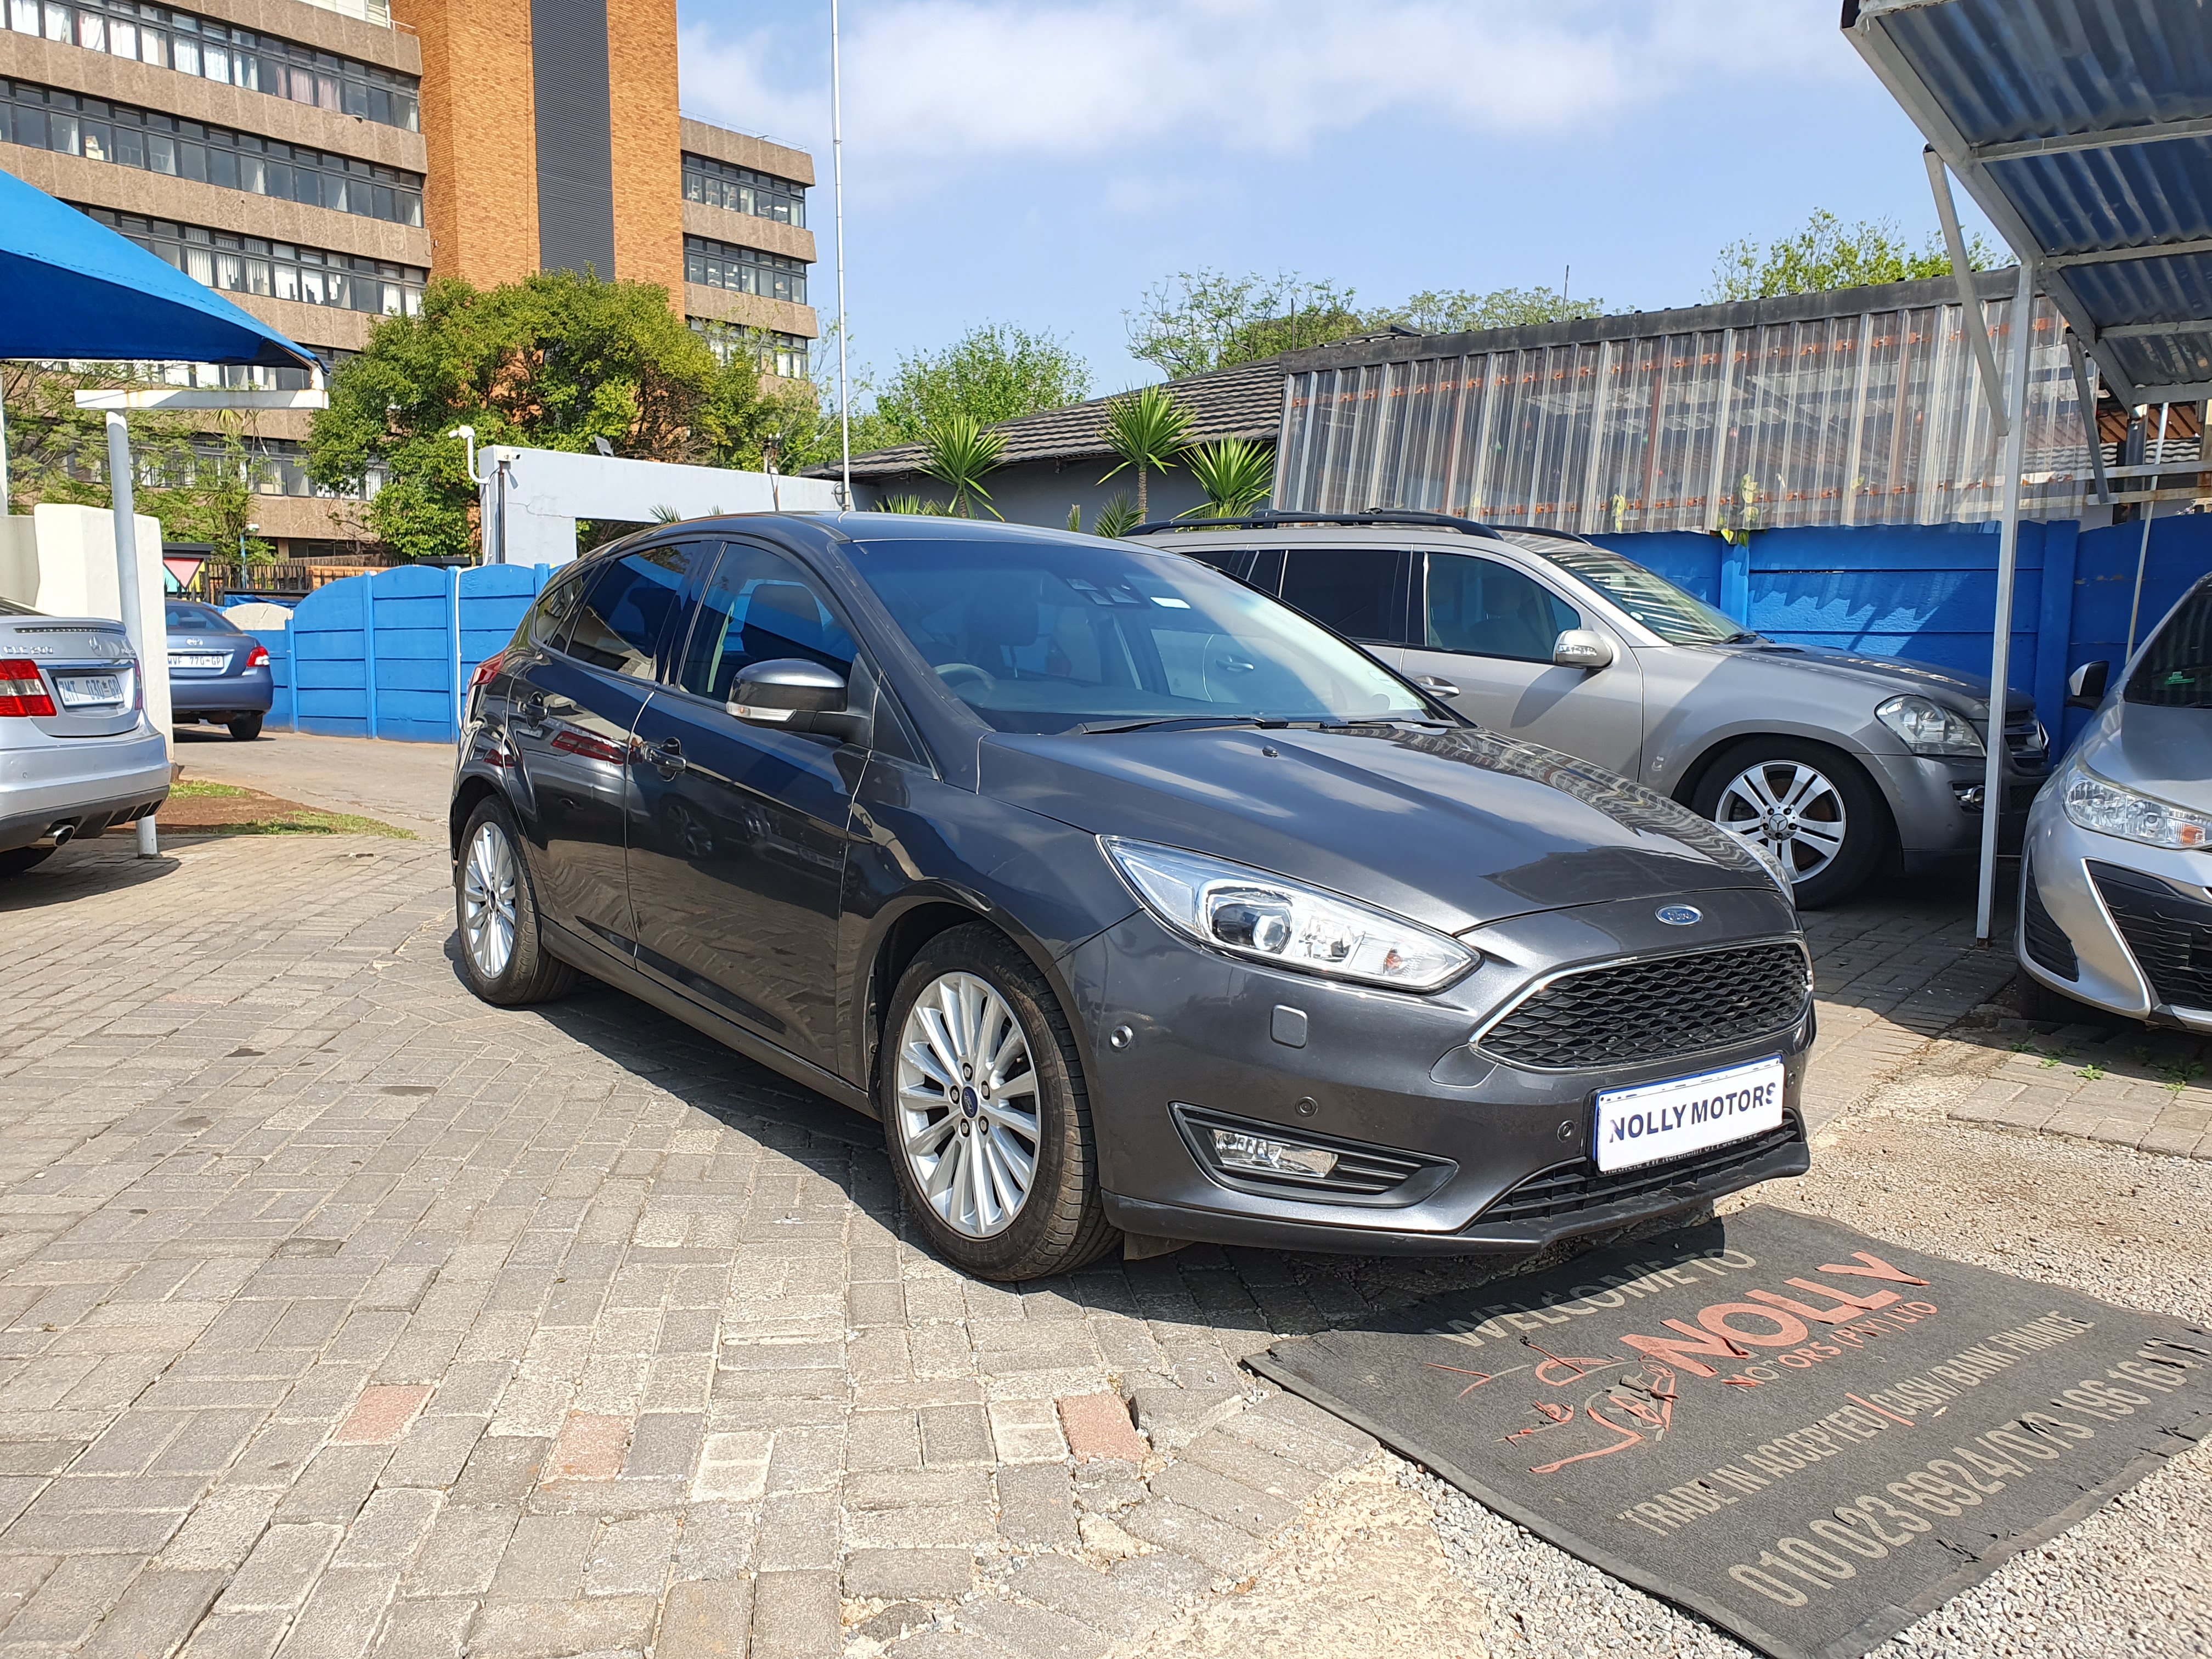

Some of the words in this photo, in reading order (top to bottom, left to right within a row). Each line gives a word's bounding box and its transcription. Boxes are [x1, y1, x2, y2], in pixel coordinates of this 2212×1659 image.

[59, 681, 80, 702] ZMT
[211, 656, 221, 665] GP
[1666, 909, 1694, 921] Ford
[1609, 1104, 1688, 1143] NOLLY
[1691, 1082, 1776, 1125] MOTORS
[1425, 1260, 1701, 1347] WELCOME
[1673, 1249, 1756, 1276] TO
[1620, 1250, 1931, 1378] NOLLY
[1720, 1341, 1842, 1392] MOTORS
[1883, 1301, 1938, 1324] LTD
[1615, 1477, 1740, 1536] TRADE
[1707, 1464, 1772, 1496] IN
[1987, 1310, 2096, 1357] FINANCE
[1728, 1537, 1857, 1607] 010
[1809, 1495, 1933, 1559] 023
[1886, 1411, 2096, 1516] 6924/073
[2049, 1379, 2152, 1422] 196
